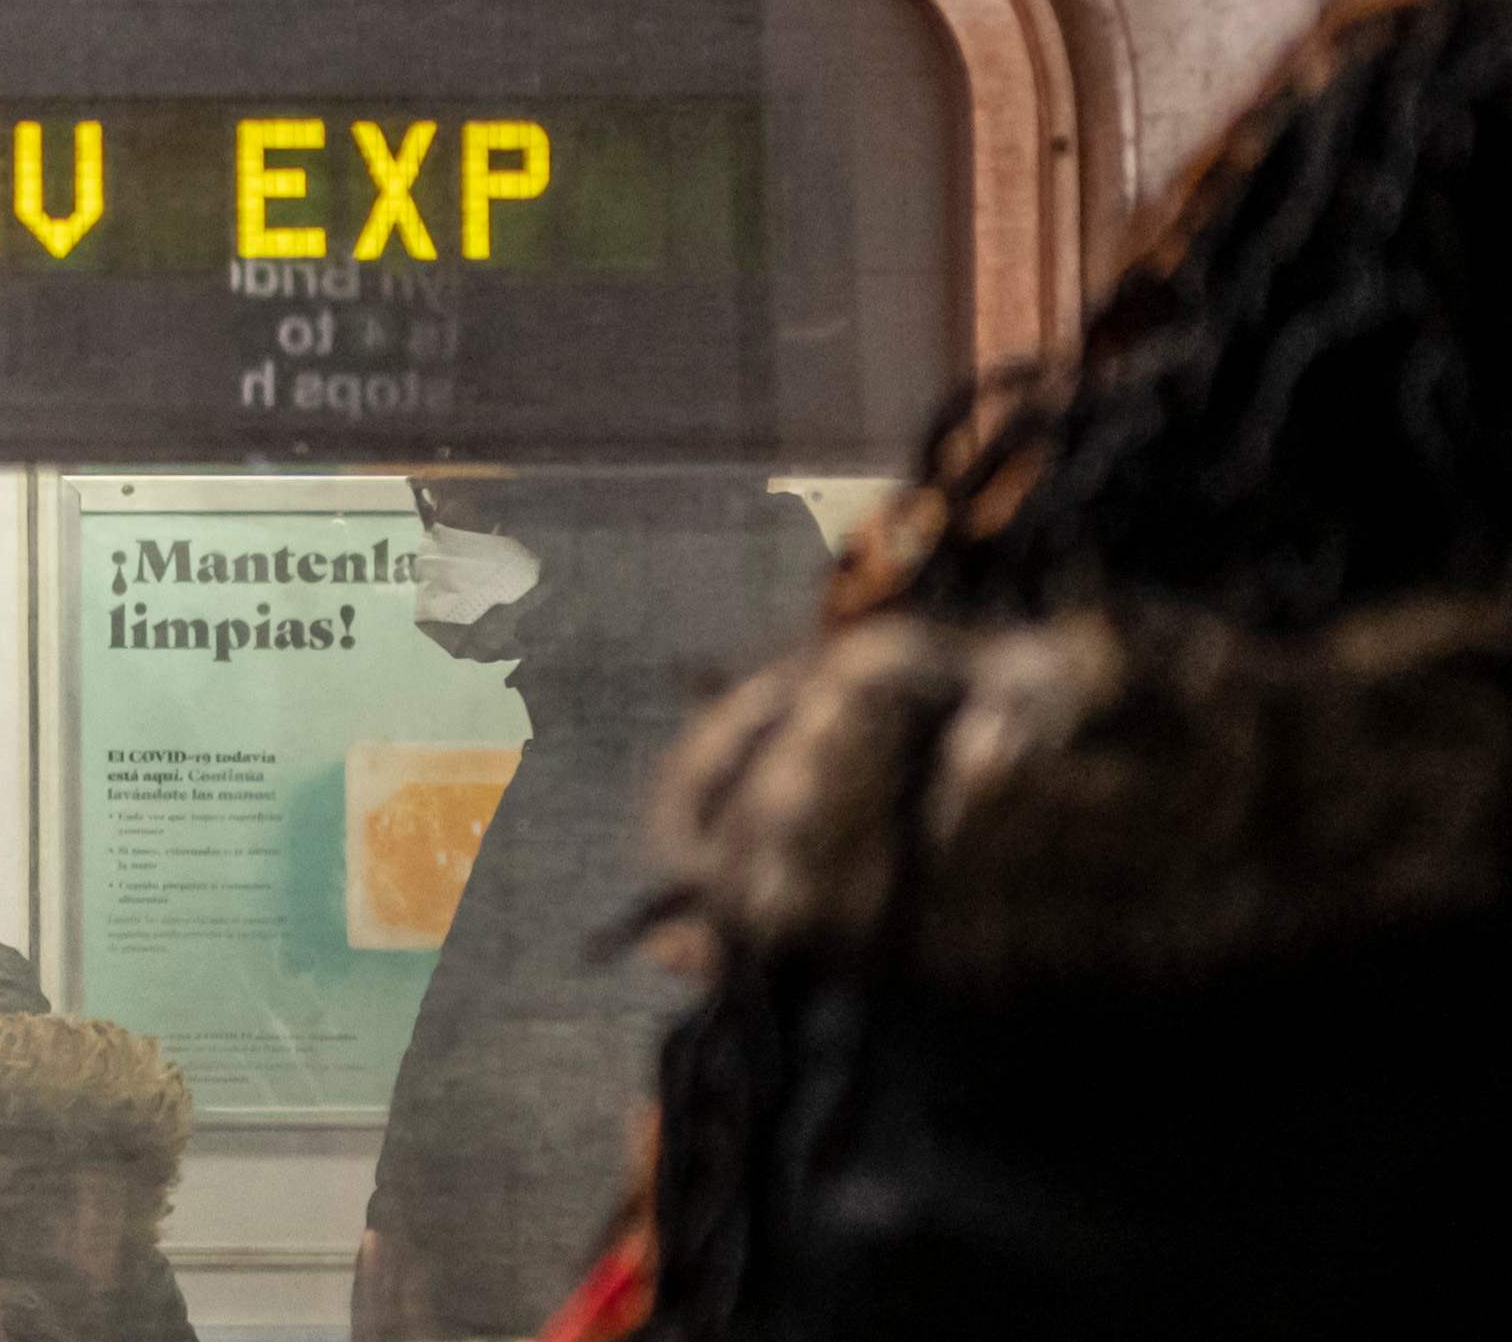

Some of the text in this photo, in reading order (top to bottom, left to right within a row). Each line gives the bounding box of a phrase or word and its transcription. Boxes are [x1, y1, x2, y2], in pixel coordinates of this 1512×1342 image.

[234, 117, 552, 261] EXP
[108, 602, 356, 662] limpias!
[107, 750, 124, 763] El
[129, 750, 211, 764] COVID-19
[107, 769, 139, 782] está
[192, 788, 214, 800] las
